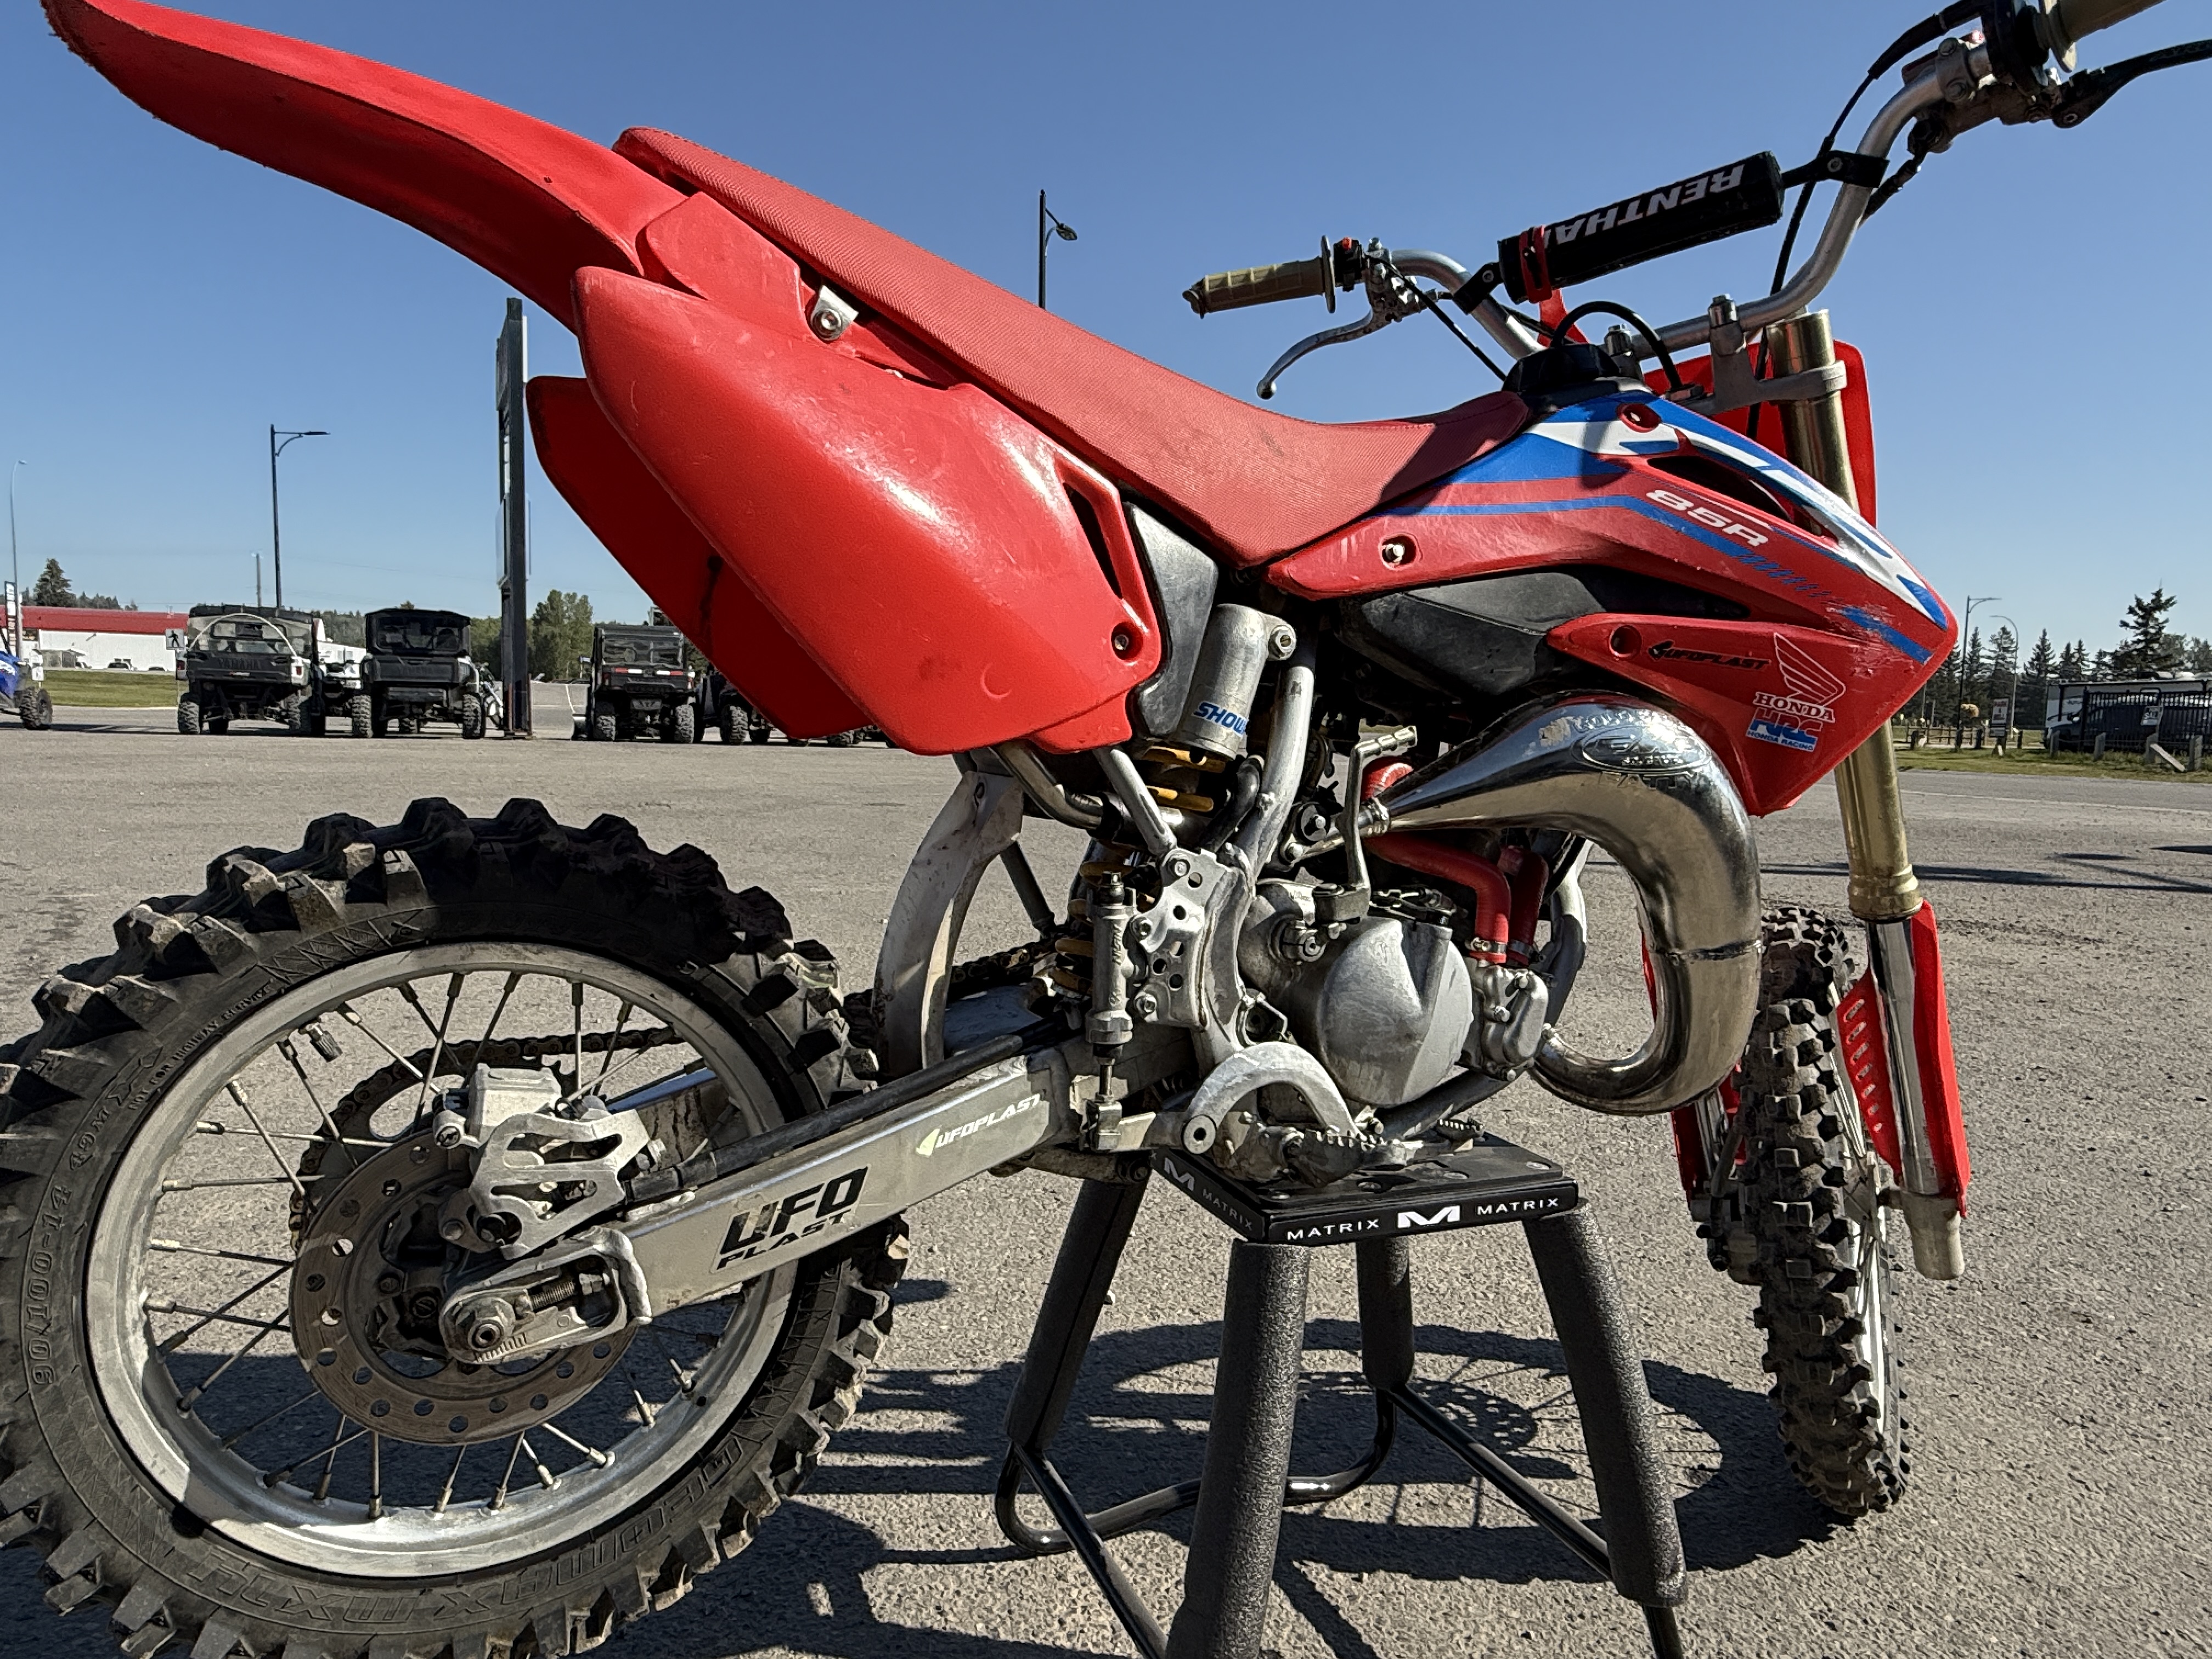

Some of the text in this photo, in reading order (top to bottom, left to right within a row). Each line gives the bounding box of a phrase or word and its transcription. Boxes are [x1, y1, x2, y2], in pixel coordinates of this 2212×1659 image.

[1646, 489, 1769, 547] 85R
[1755, 693, 1834, 721] HONDA
[1747, 730, 1815, 751] HONDA RACING
[934, 1094, 1041, 1149] UFOPLAST
[720, 1166, 869, 1255] UFO
[1203, 1188, 1252, 1231] MATRIX
[1286, 1219, 1379, 1241] MATRIX
[1477, 1198, 1559, 1215] MATRIX
[716, 1209, 851, 1270] PLAST
[25, 1186, 72, 1385] 90/100-14
